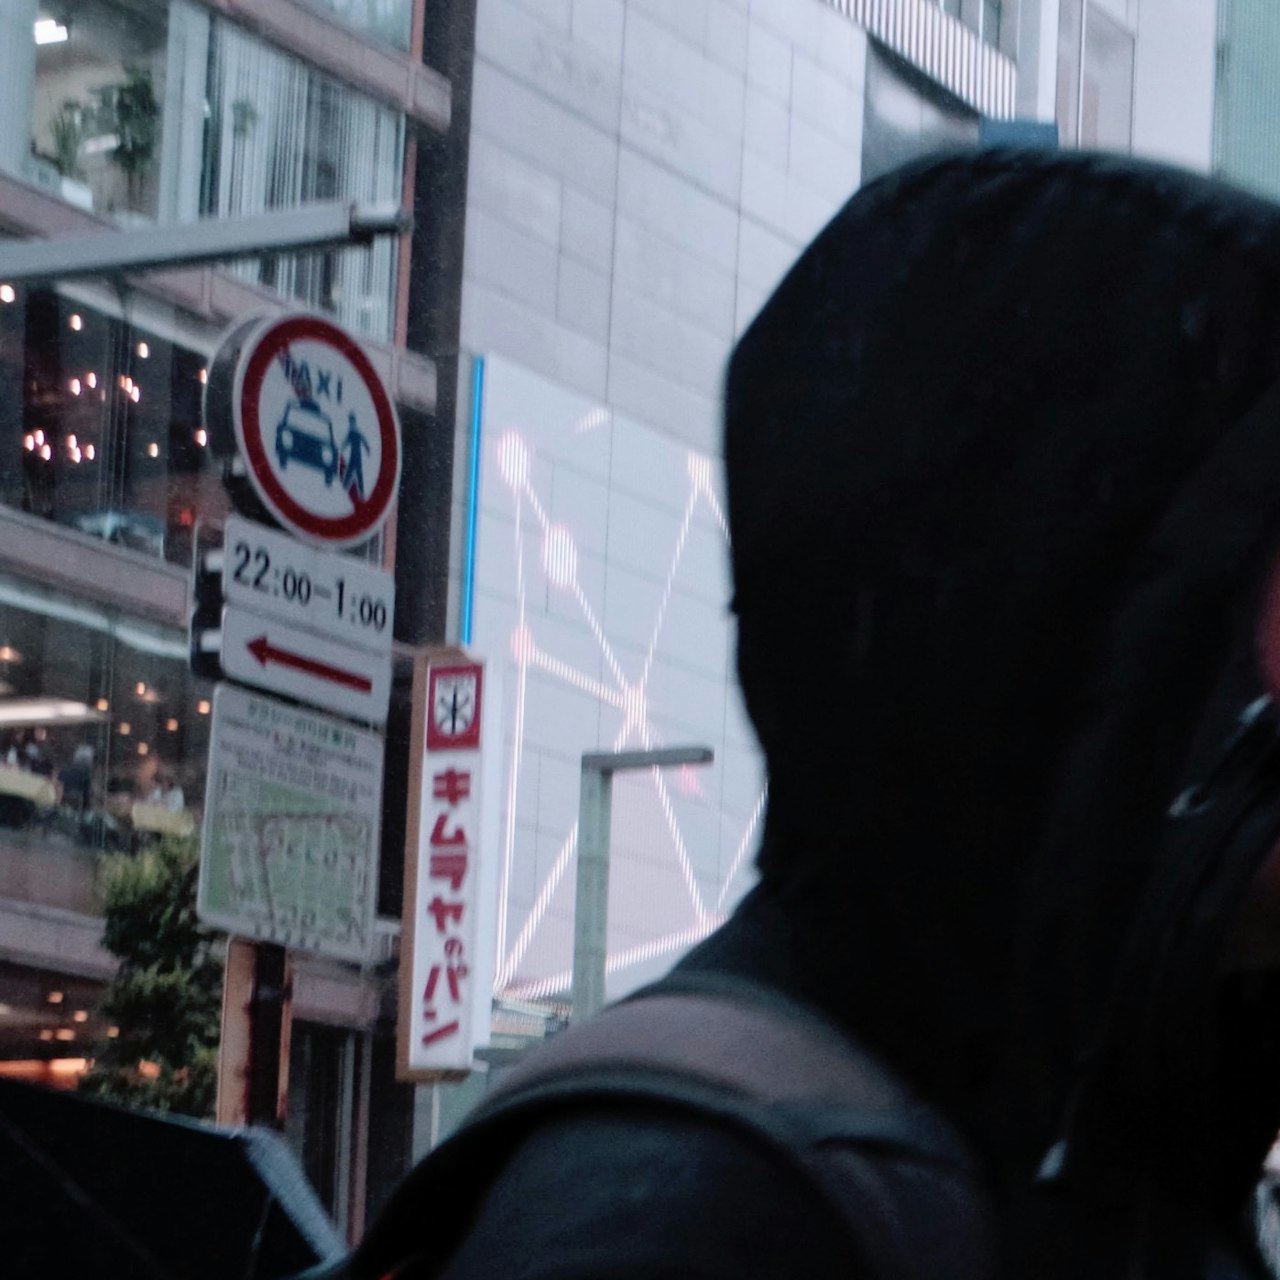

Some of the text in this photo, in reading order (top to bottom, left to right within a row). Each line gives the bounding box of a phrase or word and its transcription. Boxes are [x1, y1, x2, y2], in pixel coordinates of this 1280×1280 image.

[279, 348, 343, 404] TAXI
[422, 768, 469, 1047] キムラヤのパン
